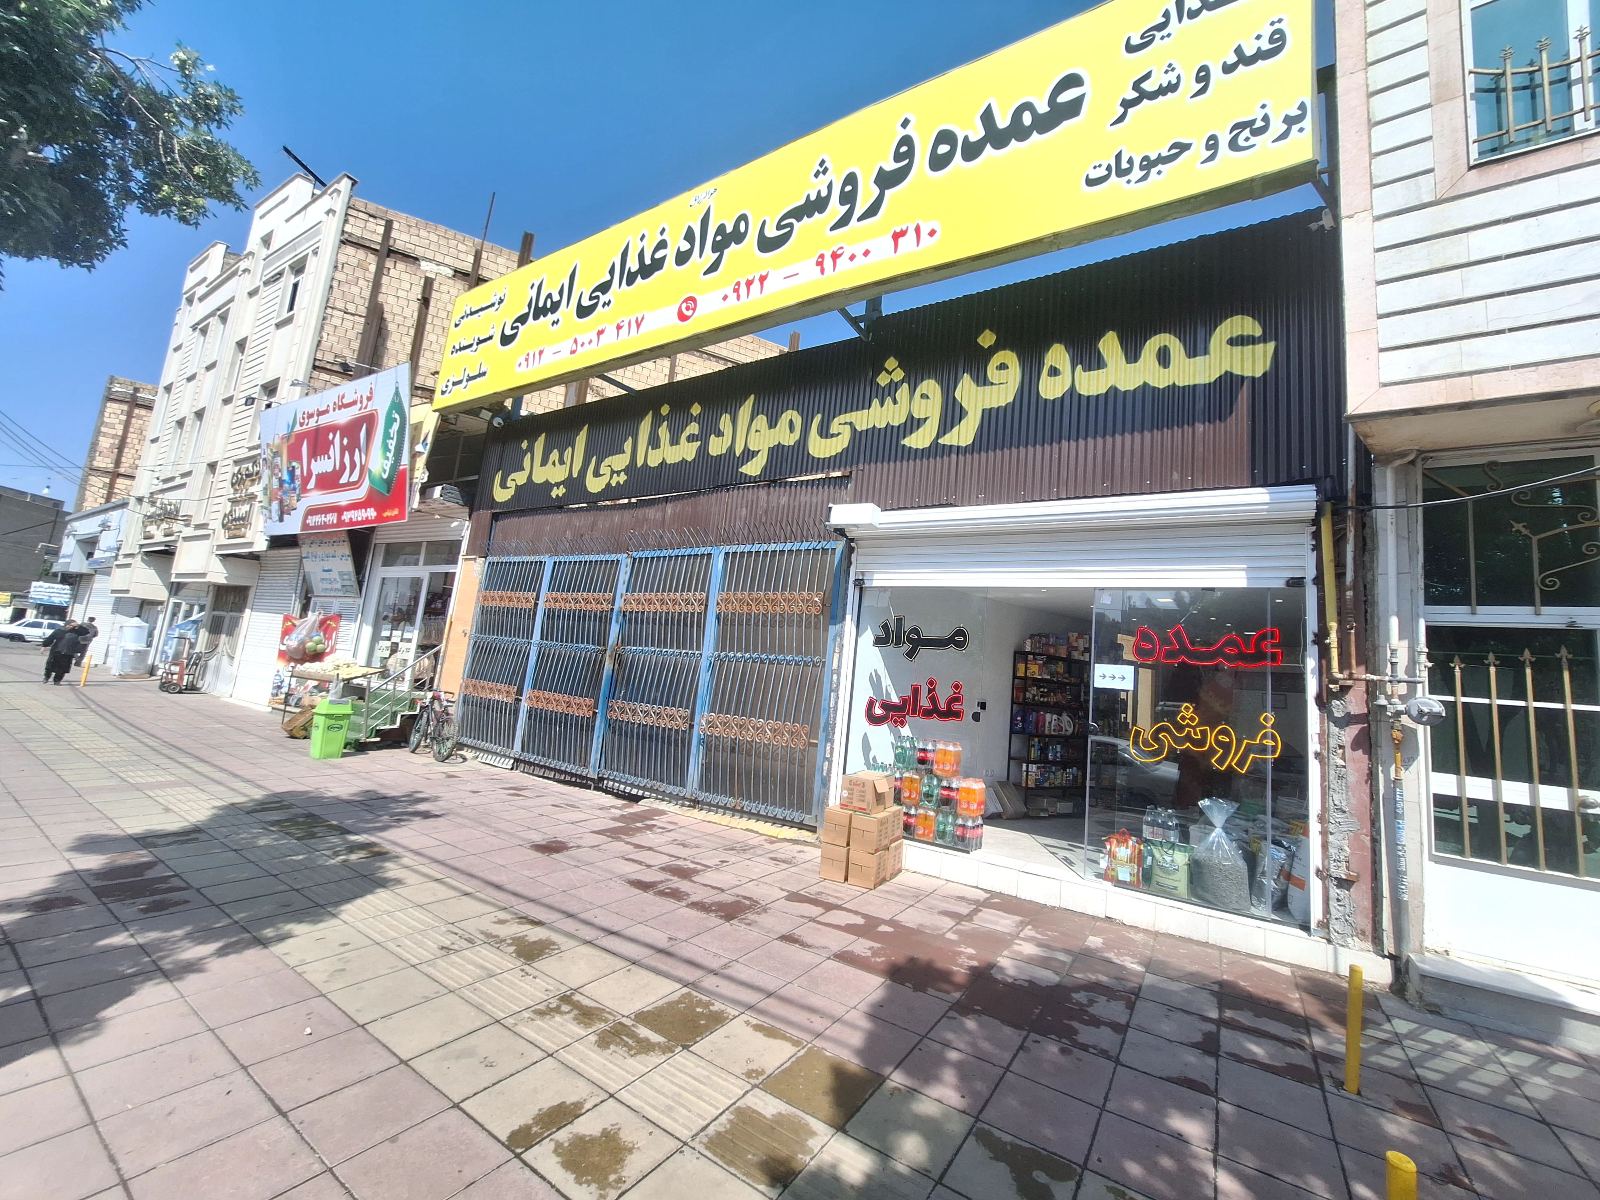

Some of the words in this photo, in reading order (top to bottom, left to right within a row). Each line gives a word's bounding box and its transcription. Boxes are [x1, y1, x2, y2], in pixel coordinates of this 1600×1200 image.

[1221, 17, 1288, 75] قند
[1109, 62, 1182, 127] شکر
[1189, 64, 1211, 99] و
[928, 72, 1087, 173] عمده
[1199, 133, 1220, 165] و
[1227, 100, 1308, 153] برنج
[756, 116, 916, 254] فروشی
[1084, 141, 1194, 188] حبوبات
[674, 204, 750, 276] مواد
[721, 271, 770, 302] ۰۹۲۲
[815, 246, 871, 276] ۹۴۰۰
[891, 222, 938, 255] ۳۱۰
[499, 263, 578, 347] ایمانی
[575, 227, 669, 320] غذایی
[454, 287, 507, 329] نوشیدنی
[517, 346, 545, 370] ۰۹۱۲
[569, 326, 608, 355] ۵۰۰۳
[616, 314, 645, 340] ۴۱۷
[1037, 314, 1277, 400] عمده
[332, 381, 375, 412] فروشگاه
[440, 361, 488, 396] سلولزی
[807, 328, 1022, 459] فروشی
[299, 404, 331, 428] موسوی
[381, 410, 401, 480] تخفیف
[585, 402, 702, 494] غذایی
[707, 393, 803, 477] مواد
[492, 423, 589, 502] ایمانی
[873, 615, 970, 663] مواد
[1132, 624, 1285, 668] عمده
[865, 676, 965, 729] غذایی
[1130, 703, 1282, 774] فروشی
